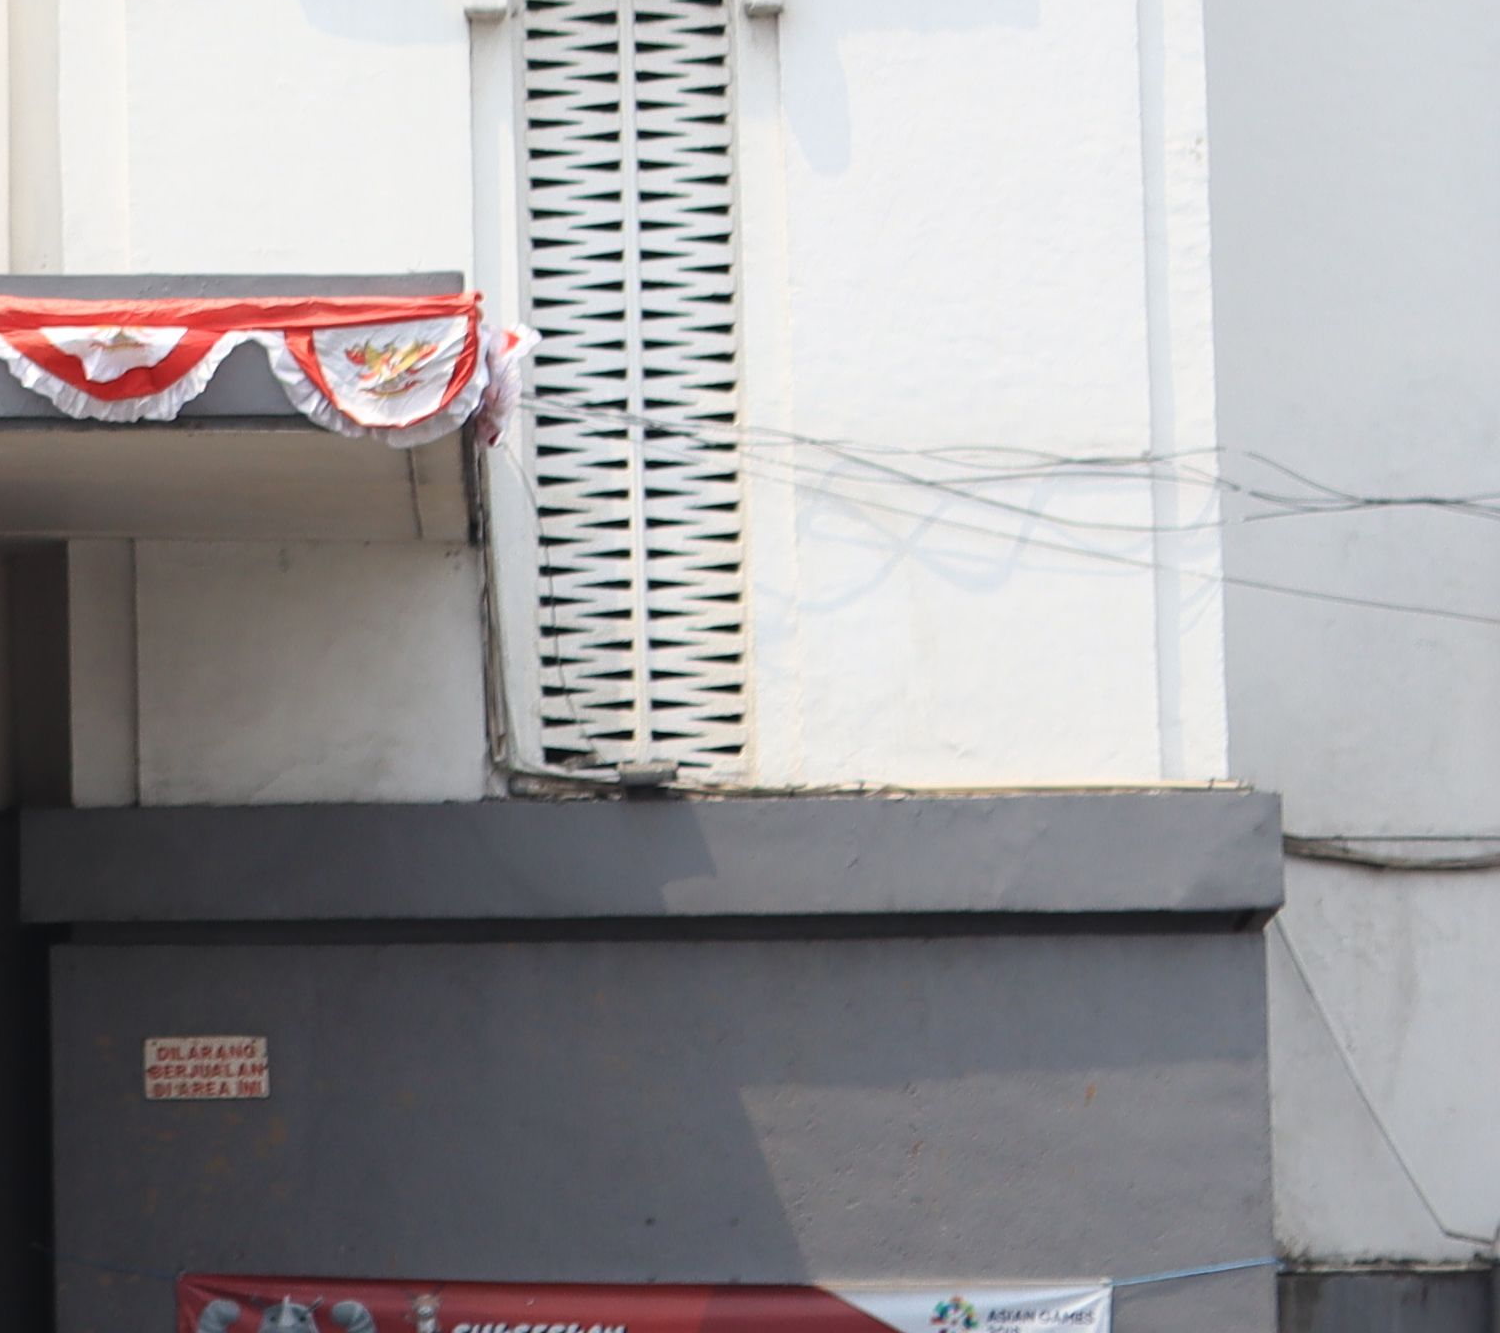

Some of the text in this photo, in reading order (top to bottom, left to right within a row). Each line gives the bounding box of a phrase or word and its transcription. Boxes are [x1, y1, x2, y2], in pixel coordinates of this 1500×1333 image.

[156, 1044, 256, 1062] DILARANG
[146, 1062, 266, 1080] BERJUALAN
[986, 1308, 1097, 1326] ASIAN GAMES
